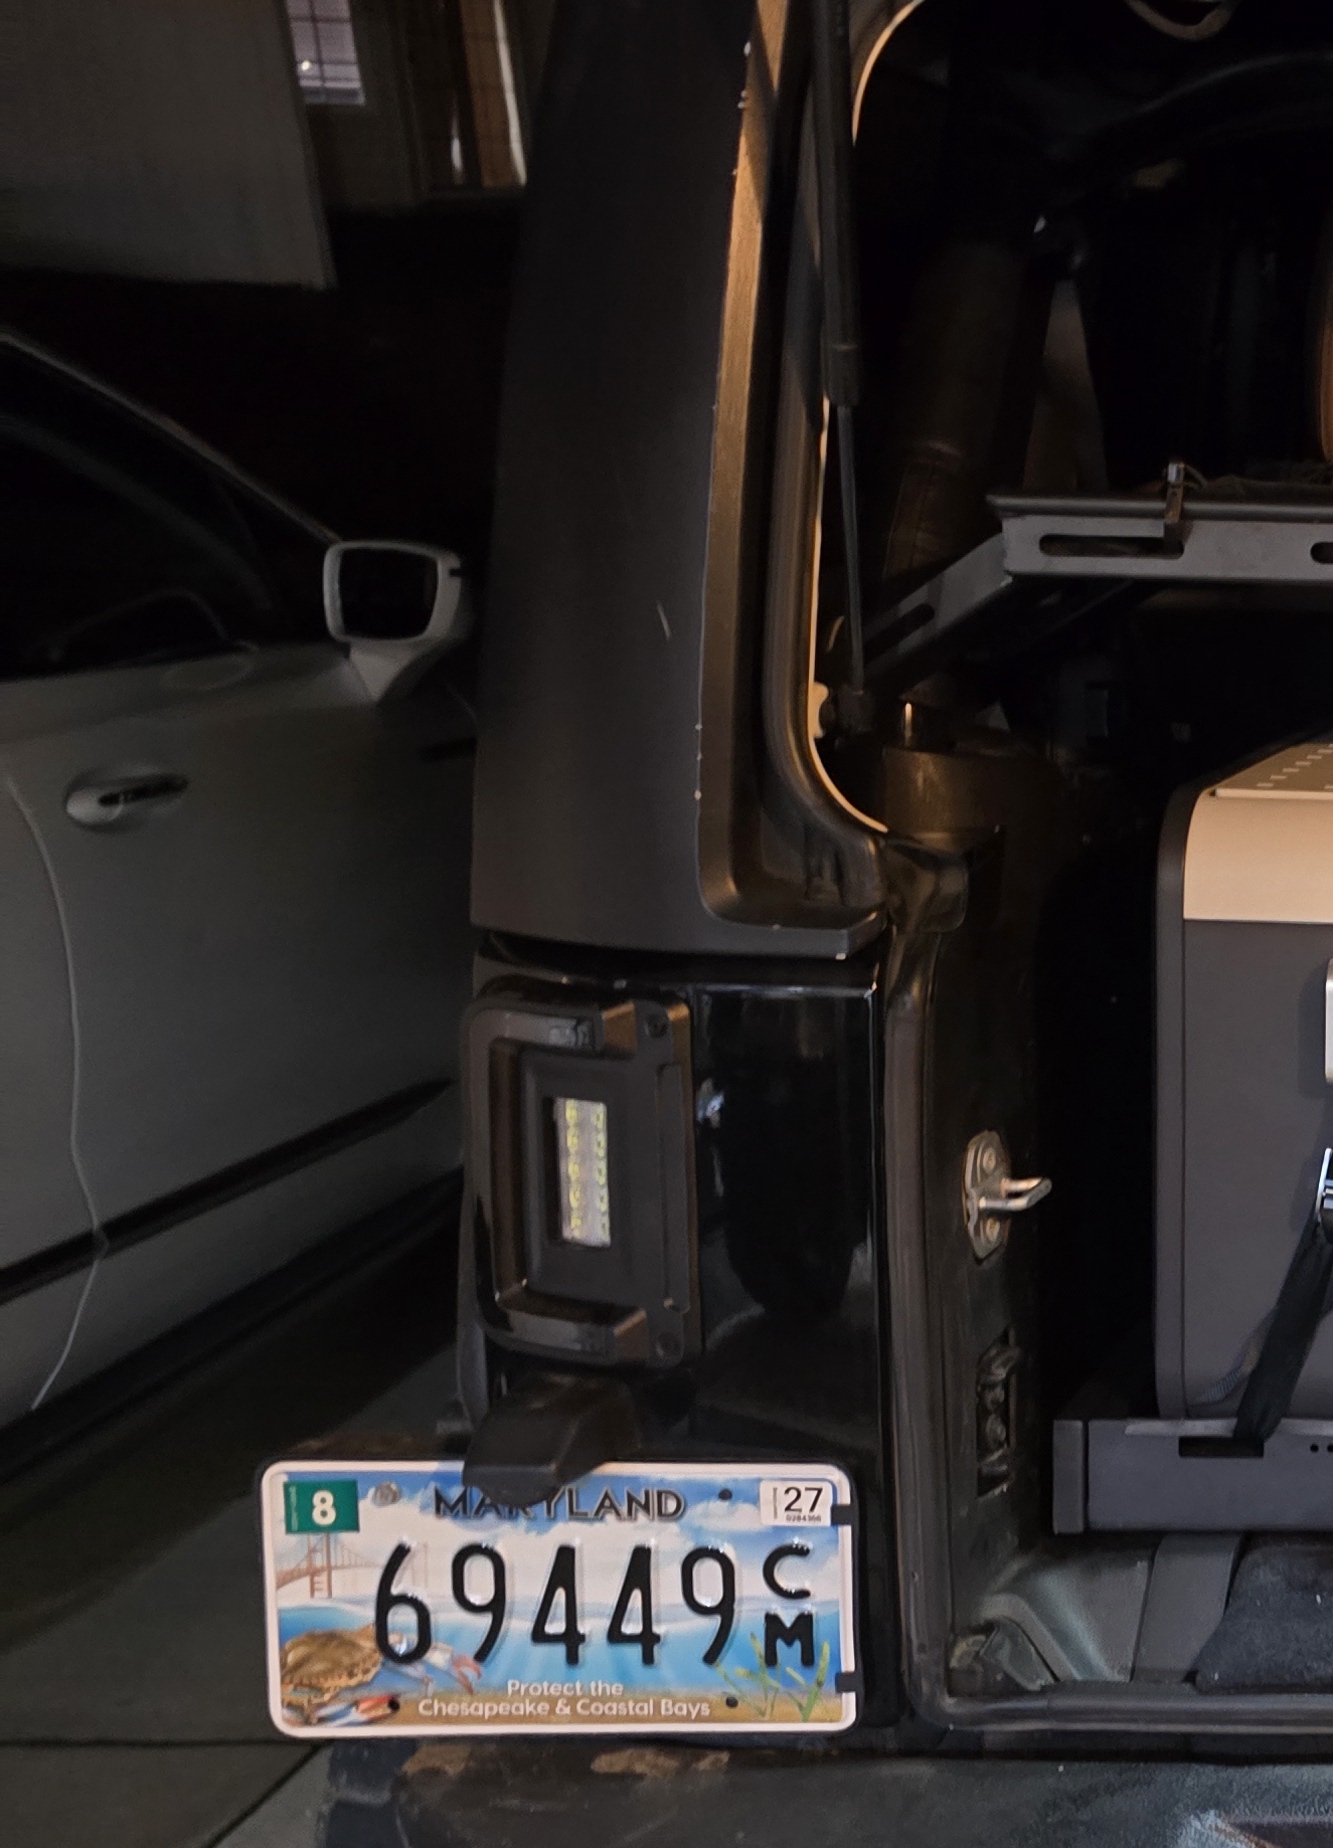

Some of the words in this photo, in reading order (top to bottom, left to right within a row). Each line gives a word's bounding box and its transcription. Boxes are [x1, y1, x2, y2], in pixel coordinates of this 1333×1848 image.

[312, 1489, 337, 1526] 8
[784, 1486, 824, 1513] 27
[375, 1543, 737, 1666] 69449
[507, 1679, 583, 1697] Protect
[590, 1679, 624, 1697] the
[418, 1698, 551, 1720] Chesapeake
[555, 1699, 572, 1716] &
[576, 1698, 654, 1717] Coastal
[660, 1698, 711, 1720] Bays
